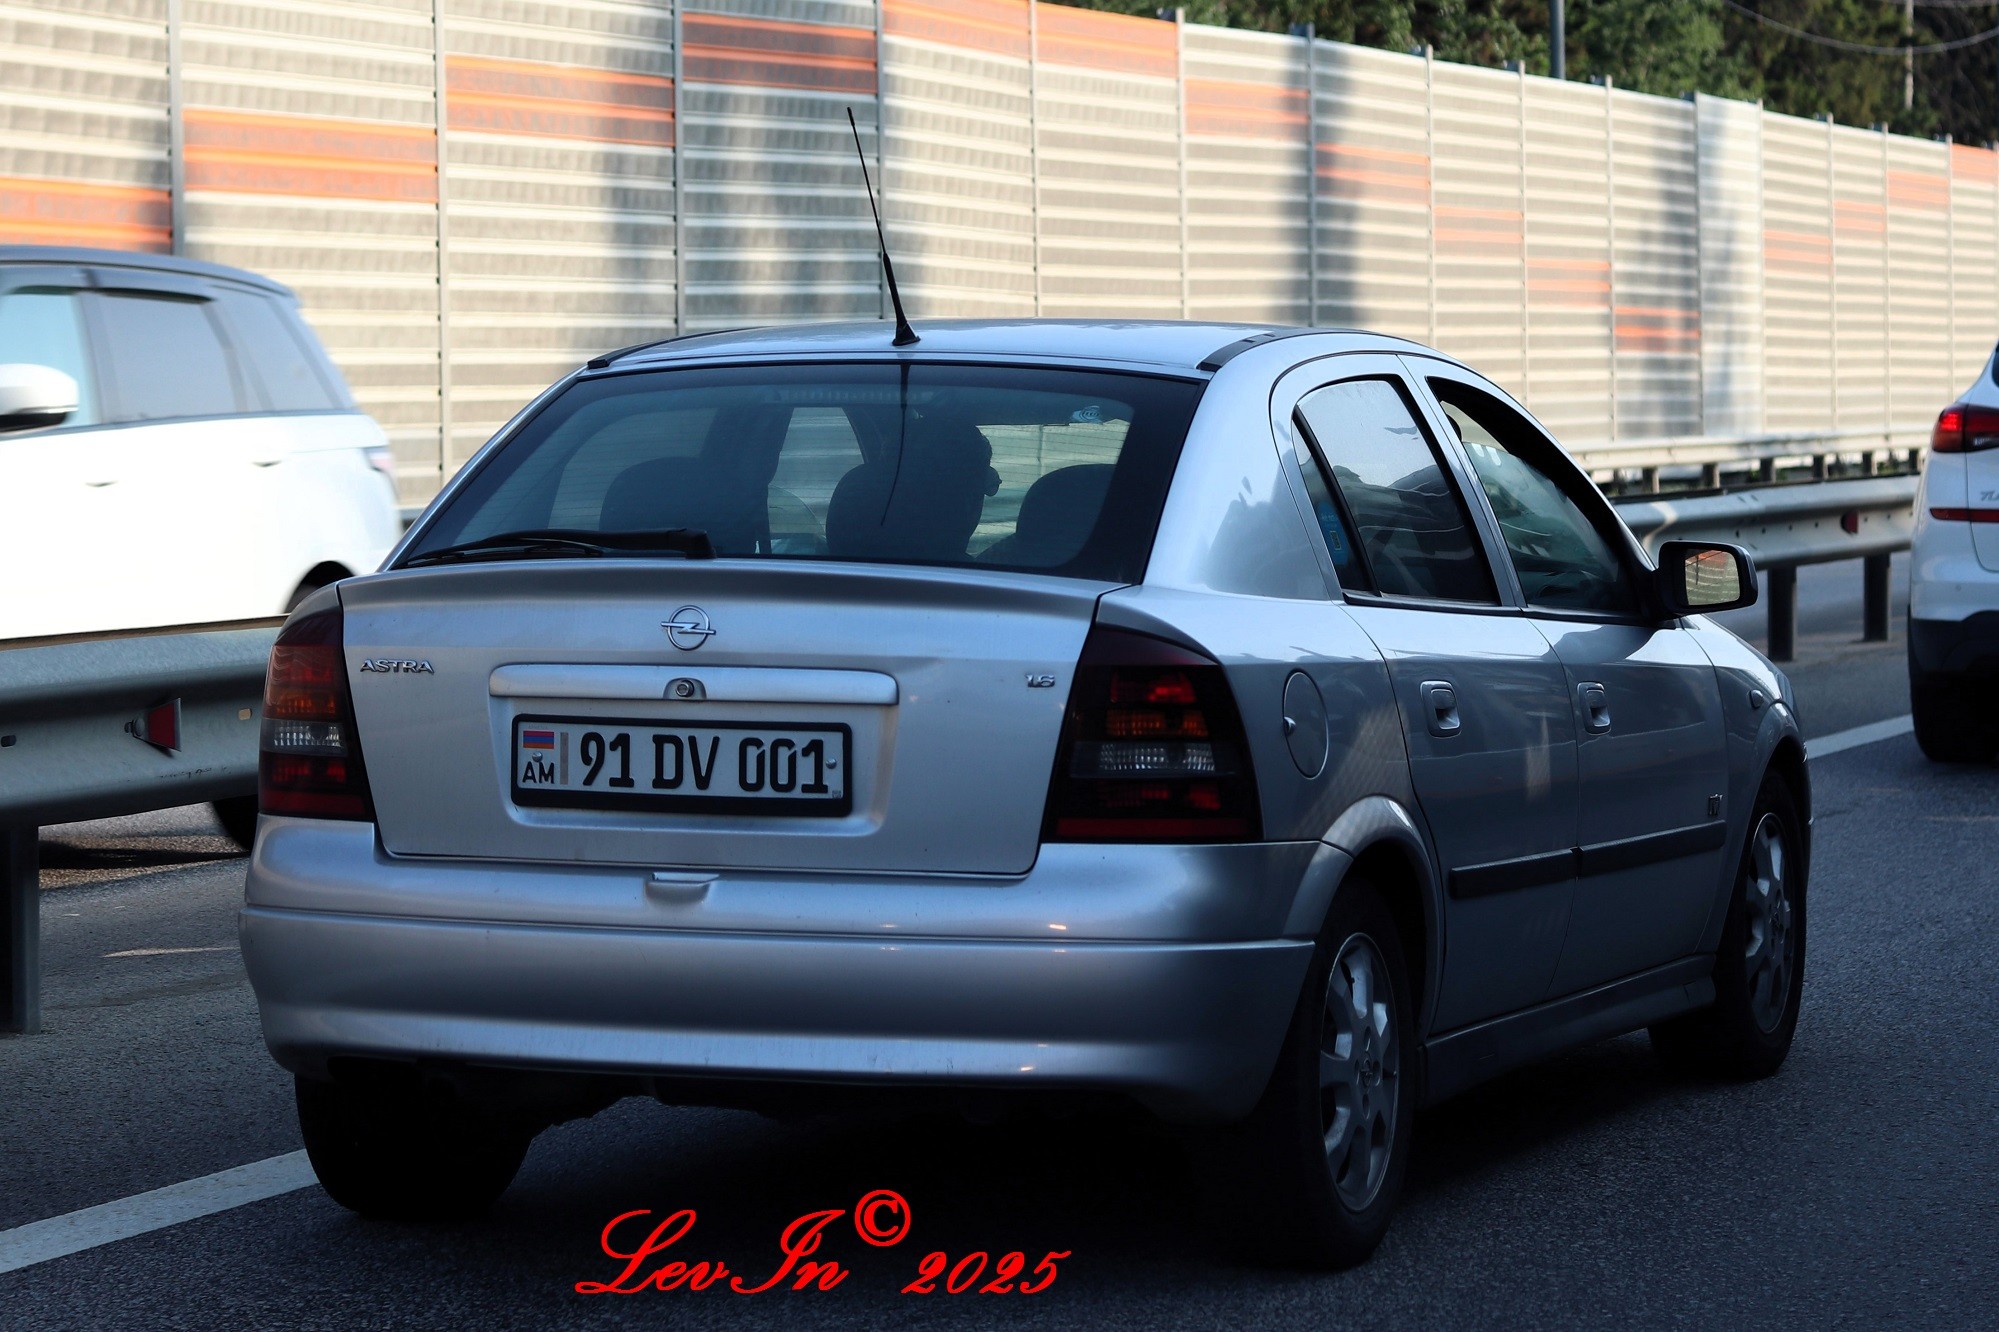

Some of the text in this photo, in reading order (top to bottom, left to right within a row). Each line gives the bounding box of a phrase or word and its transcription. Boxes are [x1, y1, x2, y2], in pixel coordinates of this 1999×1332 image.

[360, 659, 434, 674] ASTRA
[522, 761, 555, 784] AM
[580, 732, 828, 793] 91 DV 001
